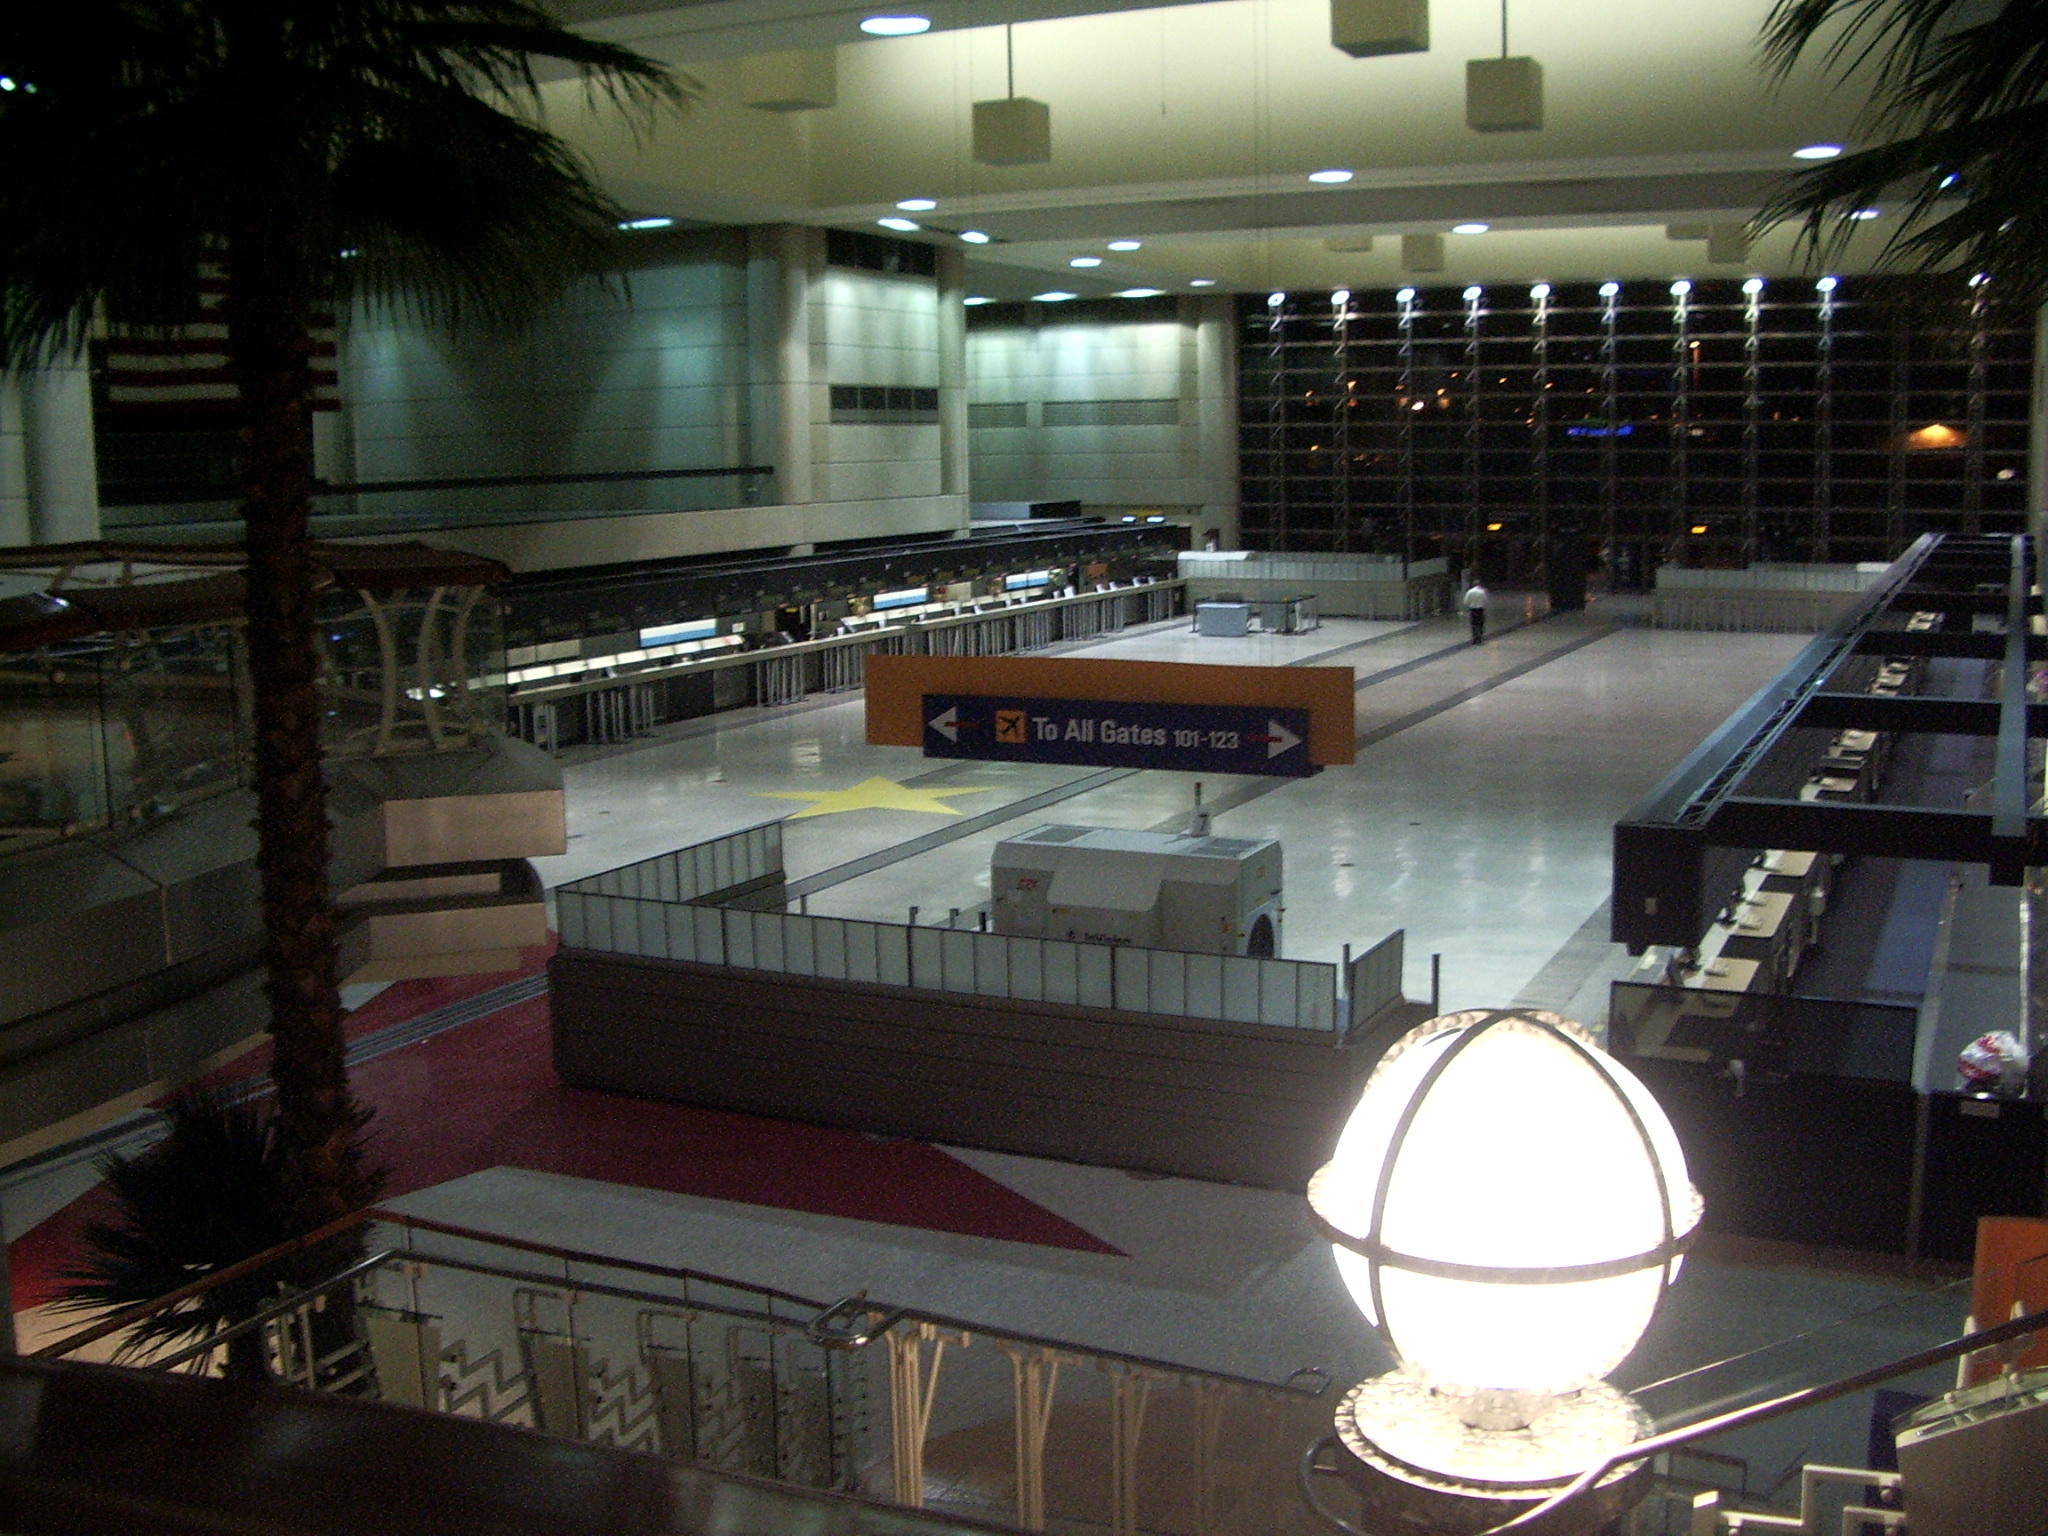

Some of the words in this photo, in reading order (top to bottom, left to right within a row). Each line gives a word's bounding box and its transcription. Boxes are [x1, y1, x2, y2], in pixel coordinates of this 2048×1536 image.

[1032, 716, 1058, 741] To
[1064, 719, 1095, 743] All
[1101, 719, 1167, 746] Gates
[1173, 729, 1240, 749] 101-123
